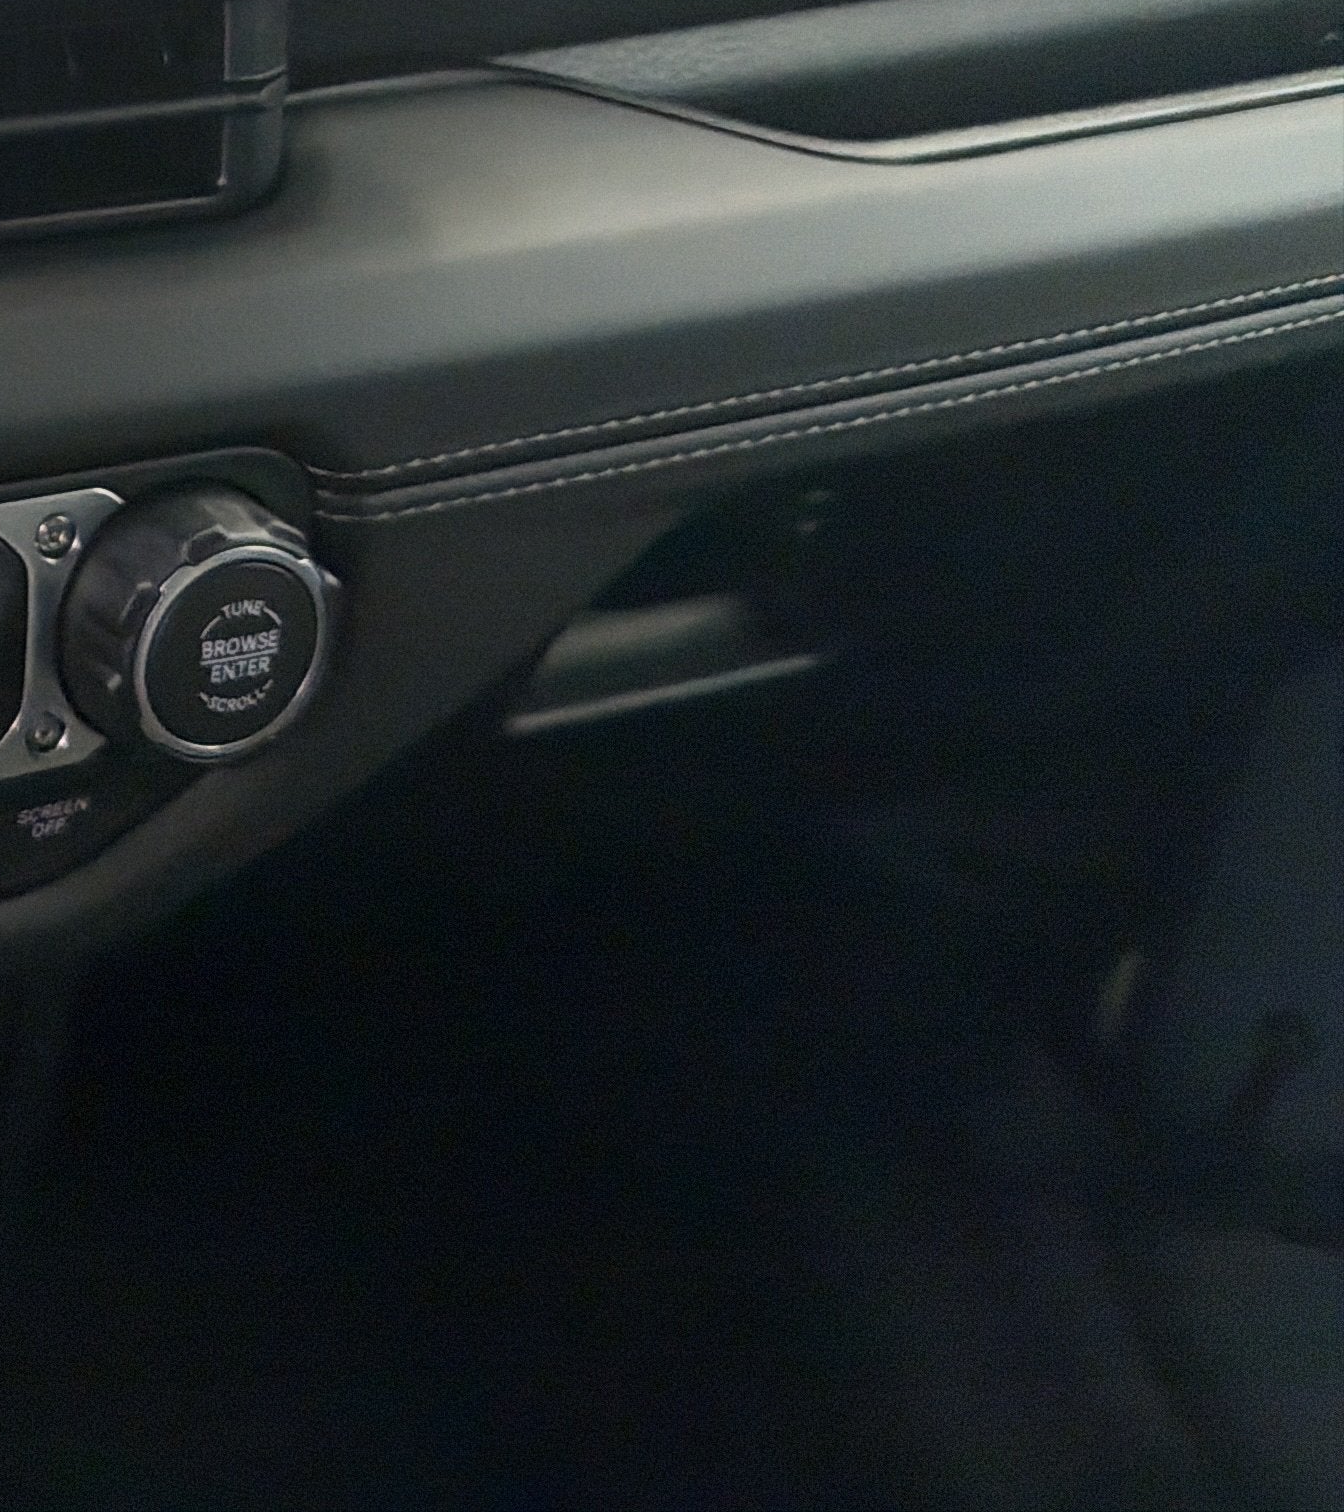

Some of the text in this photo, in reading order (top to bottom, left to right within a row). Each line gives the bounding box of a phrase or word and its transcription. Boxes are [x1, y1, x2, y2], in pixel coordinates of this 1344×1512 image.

[220, 599, 267, 620] TUNE
[201, 630, 280, 659] BROWSE
[209, 657, 271, 684] ENTER
